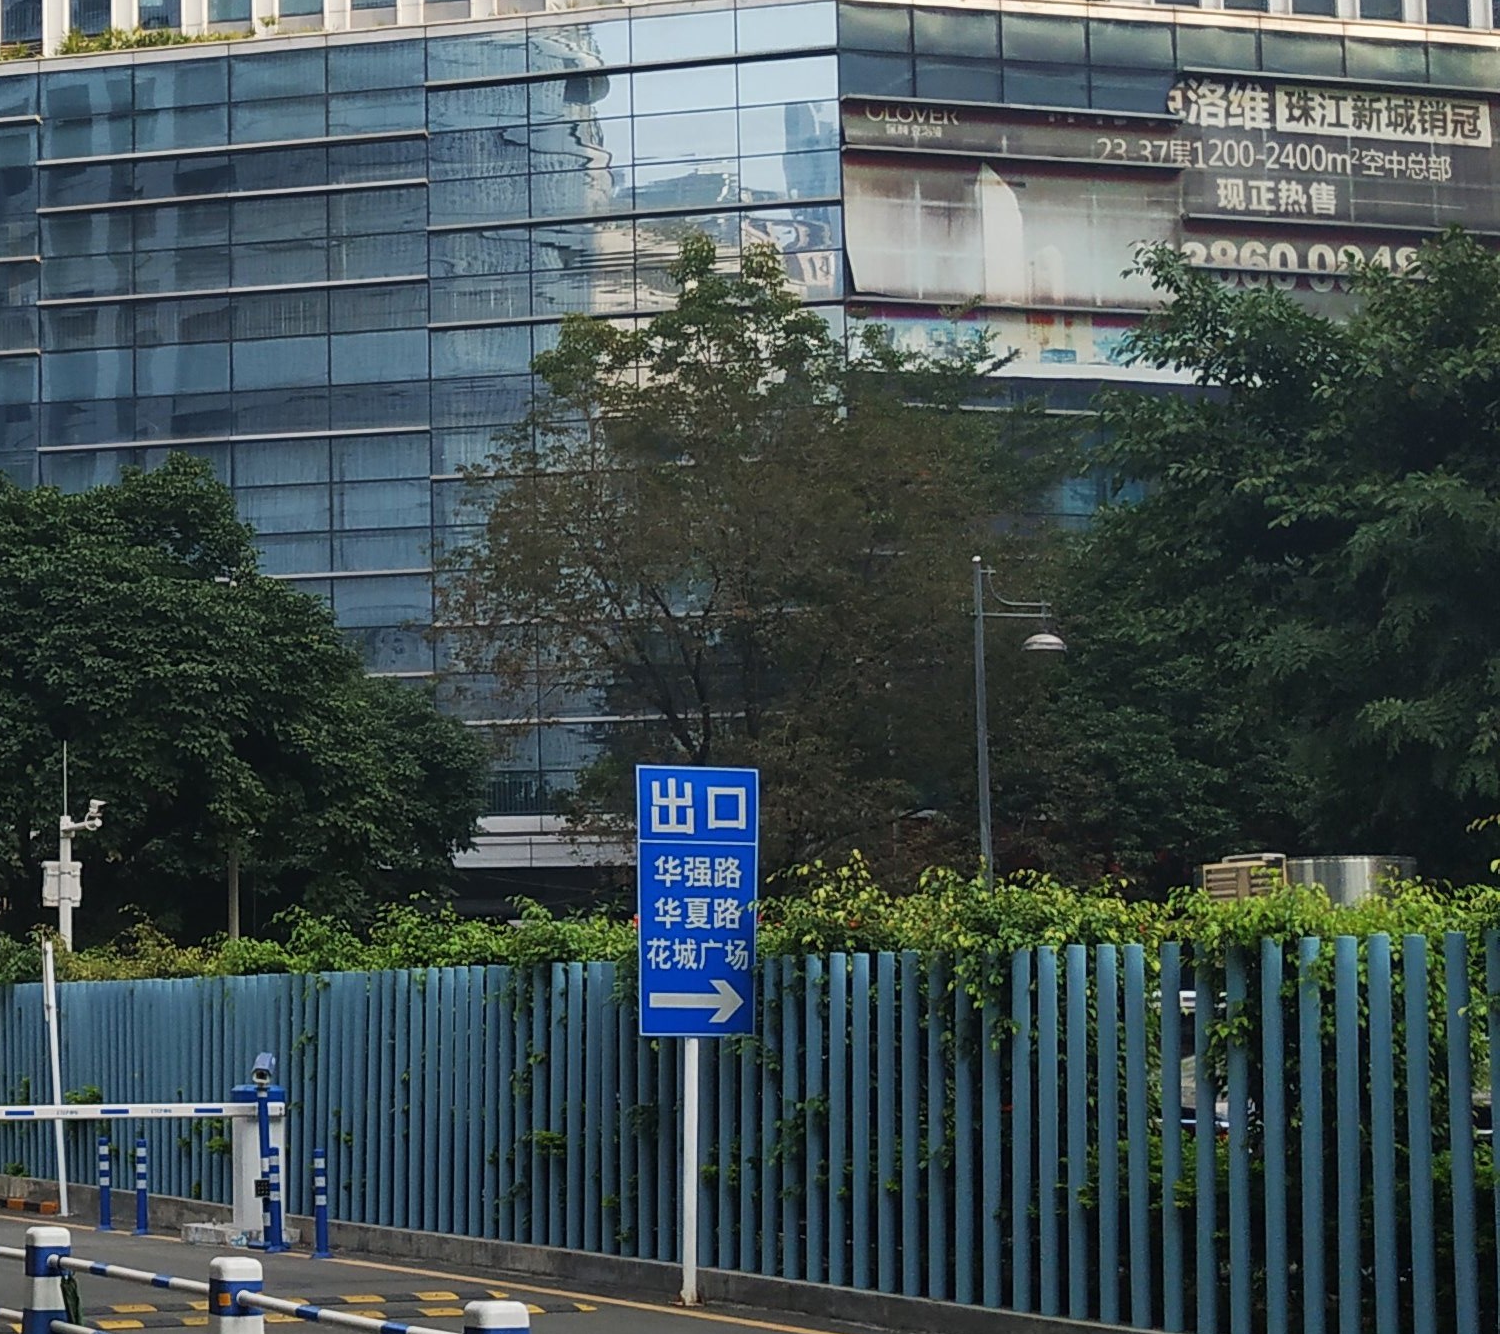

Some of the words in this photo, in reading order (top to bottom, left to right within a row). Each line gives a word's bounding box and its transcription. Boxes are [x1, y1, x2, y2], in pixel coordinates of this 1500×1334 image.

[1283, 89, 1482, 140] 珠江新城销冠
[1216, 177, 1337, 215] 现正热售
[651, 777, 747, 835] 出口
[654, 855, 743, 889] 华强路
[654, 897, 742, 930] 华夏路
[646, 938, 750, 972] 花城广场
